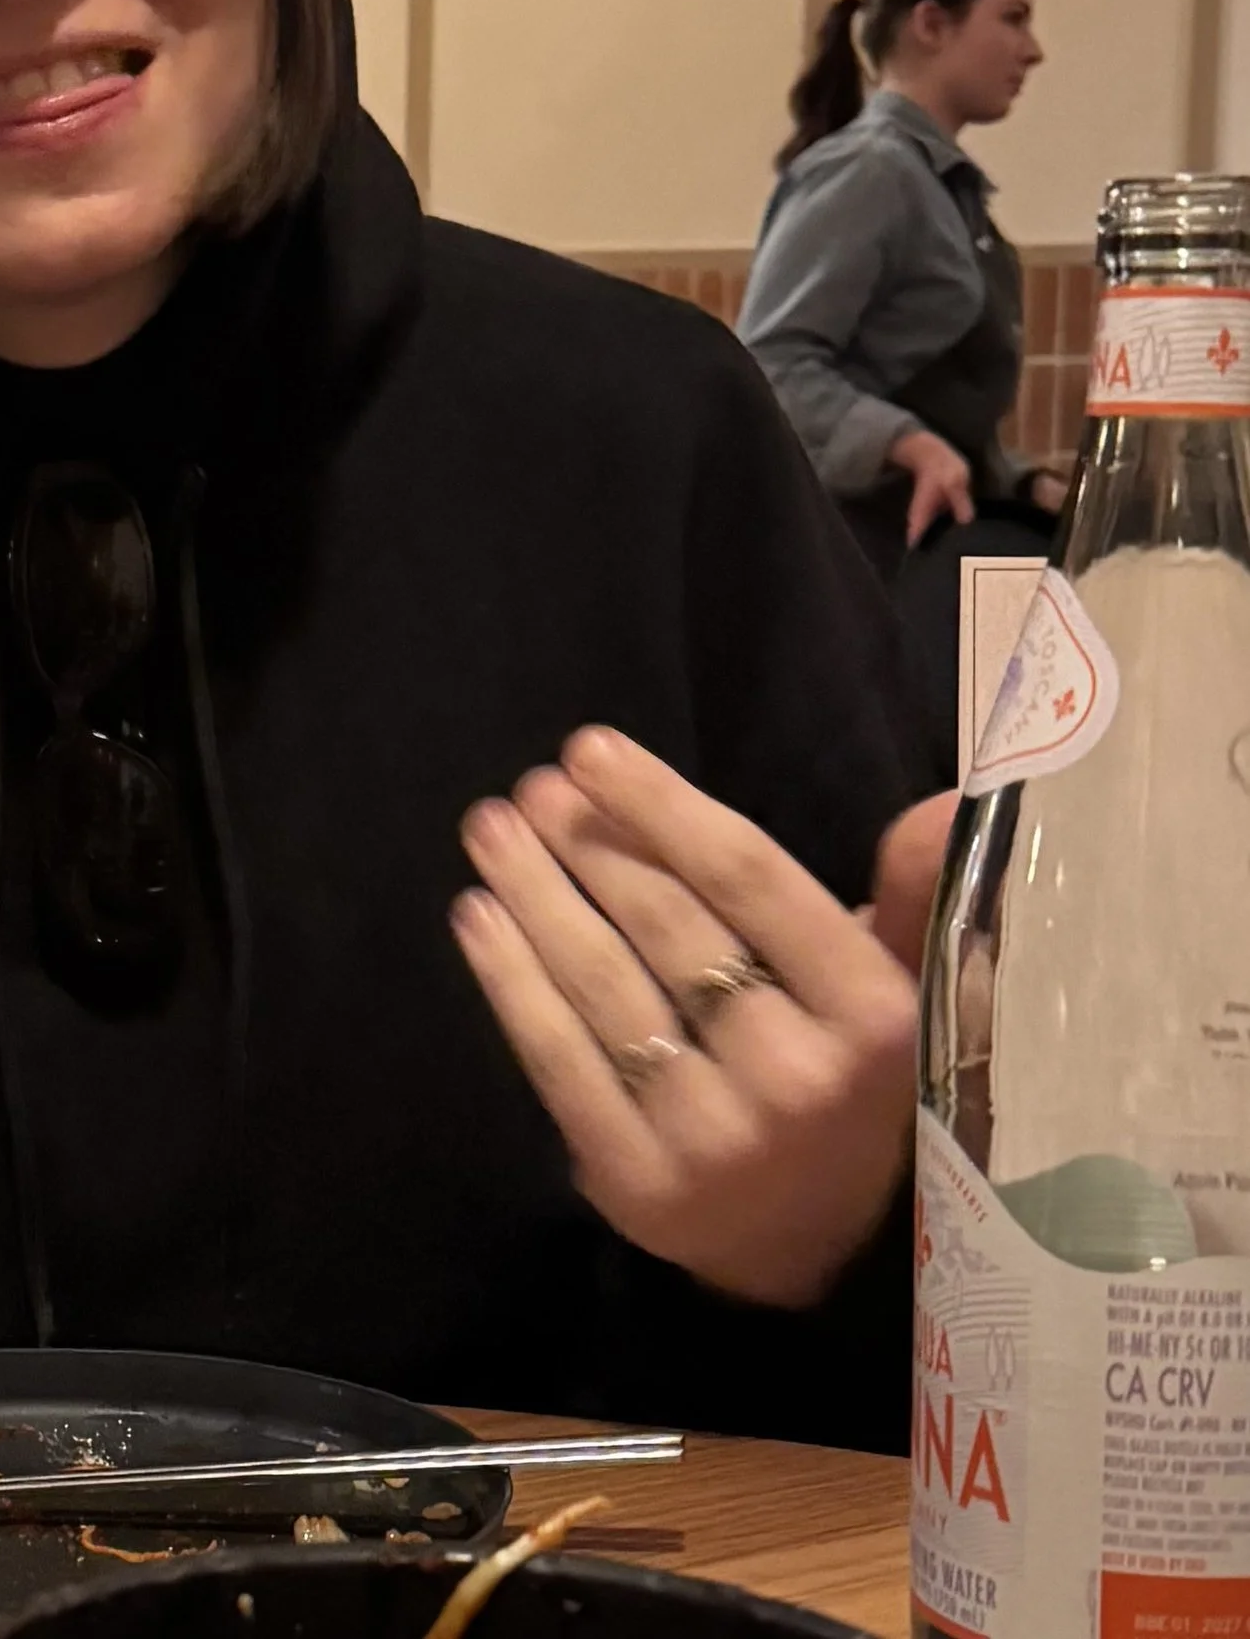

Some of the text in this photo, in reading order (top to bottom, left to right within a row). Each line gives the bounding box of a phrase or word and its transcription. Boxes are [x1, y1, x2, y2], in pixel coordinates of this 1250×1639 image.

[1105, 1362, 1216, 1408] CA CRV
[941, 1558, 997, 1609] WATER
